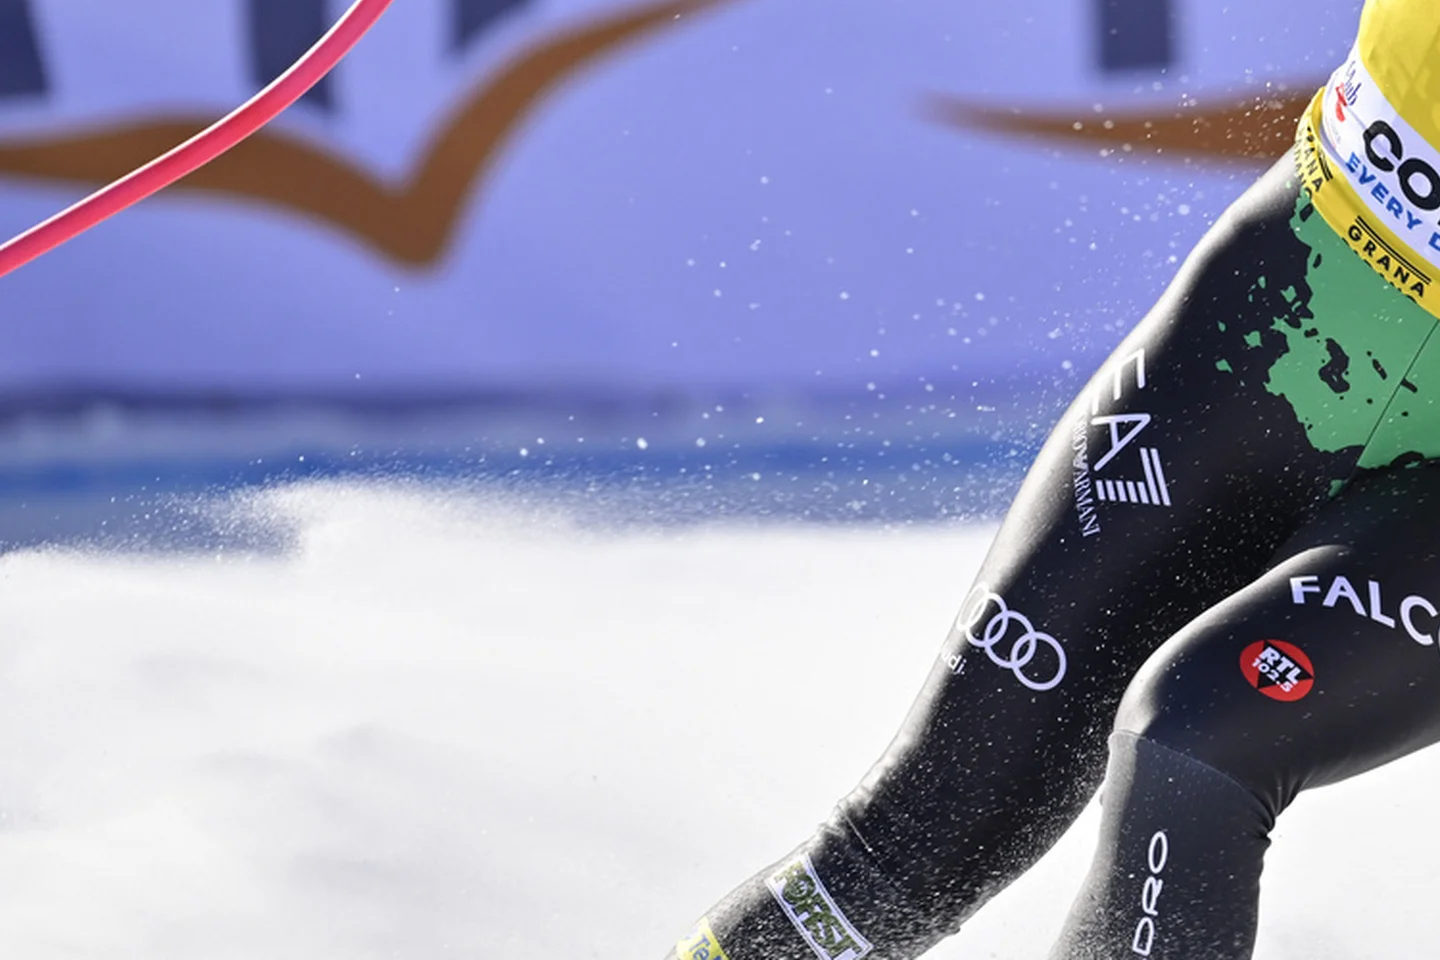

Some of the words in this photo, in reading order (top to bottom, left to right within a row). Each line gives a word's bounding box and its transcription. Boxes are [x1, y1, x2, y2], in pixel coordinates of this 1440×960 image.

[1345, 151, 1423, 231] EVERY
[1347, 224, 1426, 299] GRANA
[1251, 657, 1294, 693] 102.5
[1258, 646, 1302, 686] RTL
